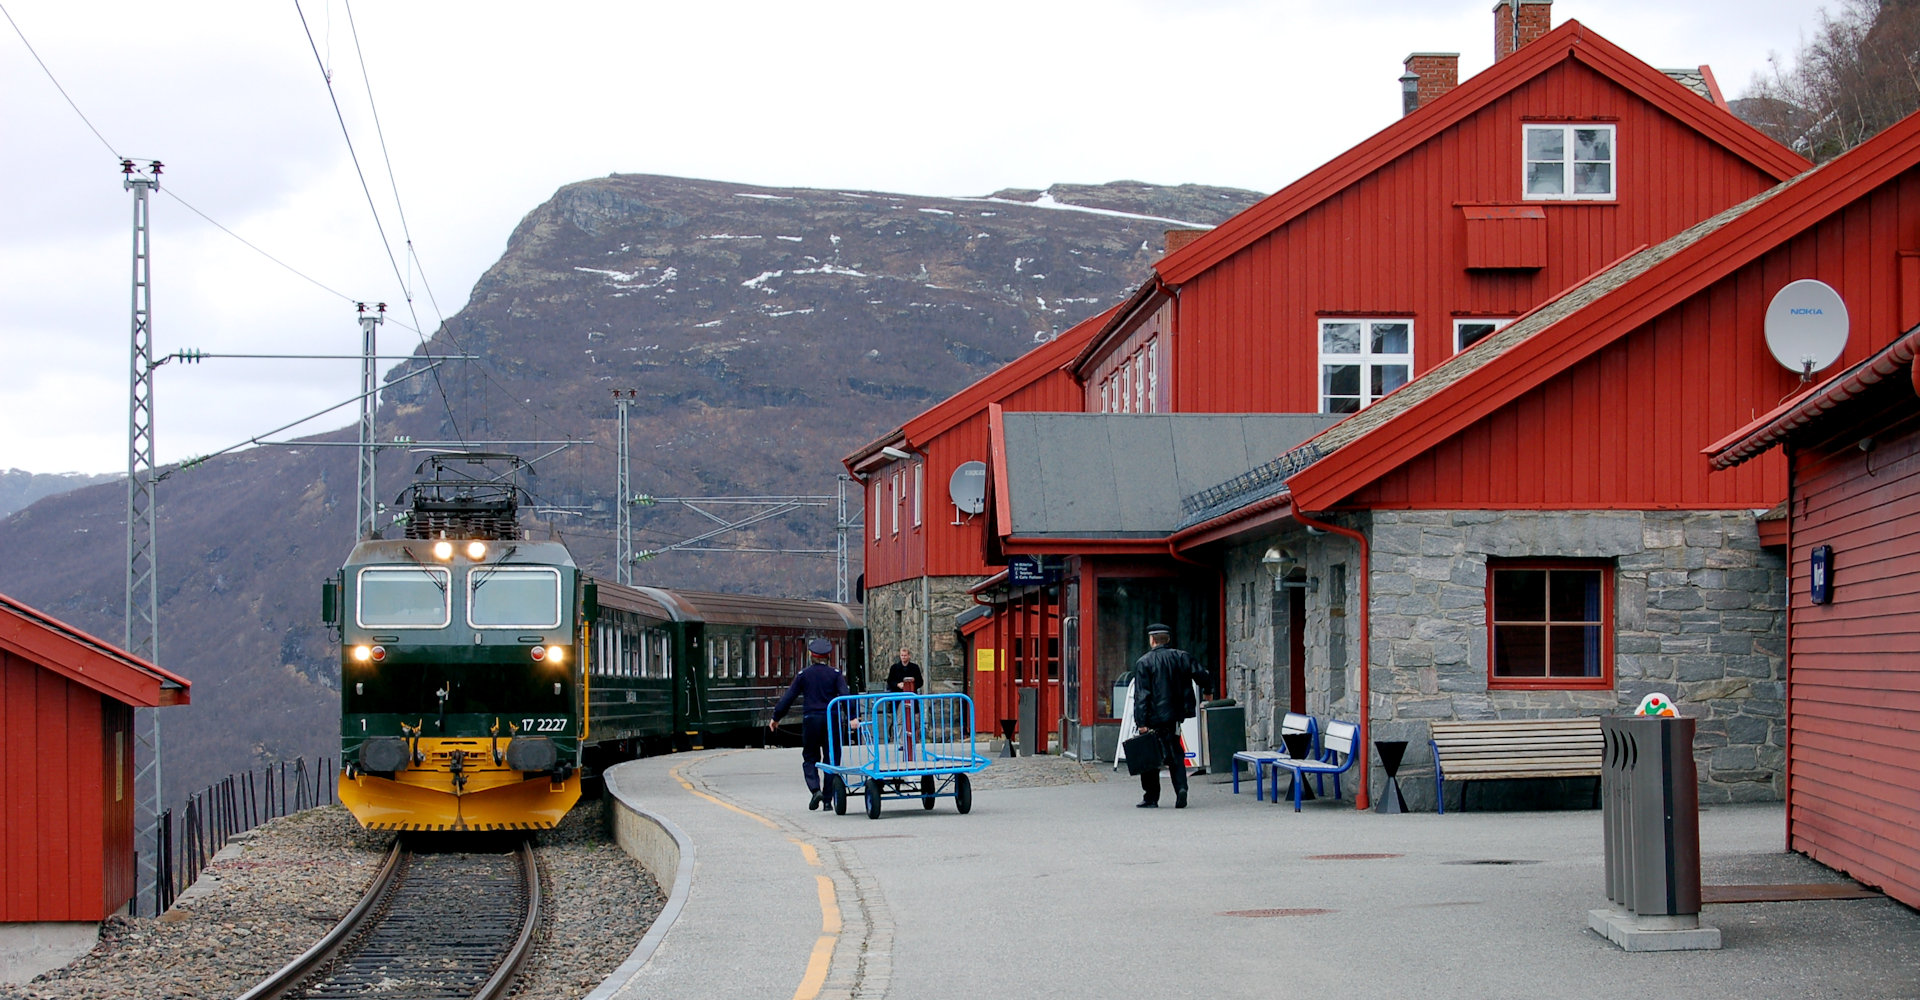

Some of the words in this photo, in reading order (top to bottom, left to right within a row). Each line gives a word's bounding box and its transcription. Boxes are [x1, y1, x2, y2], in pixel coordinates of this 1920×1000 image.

[360, 718, 367, 731] 1
[521, 718, 535, 731] 17
[537, 718, 568, 731] 2227
